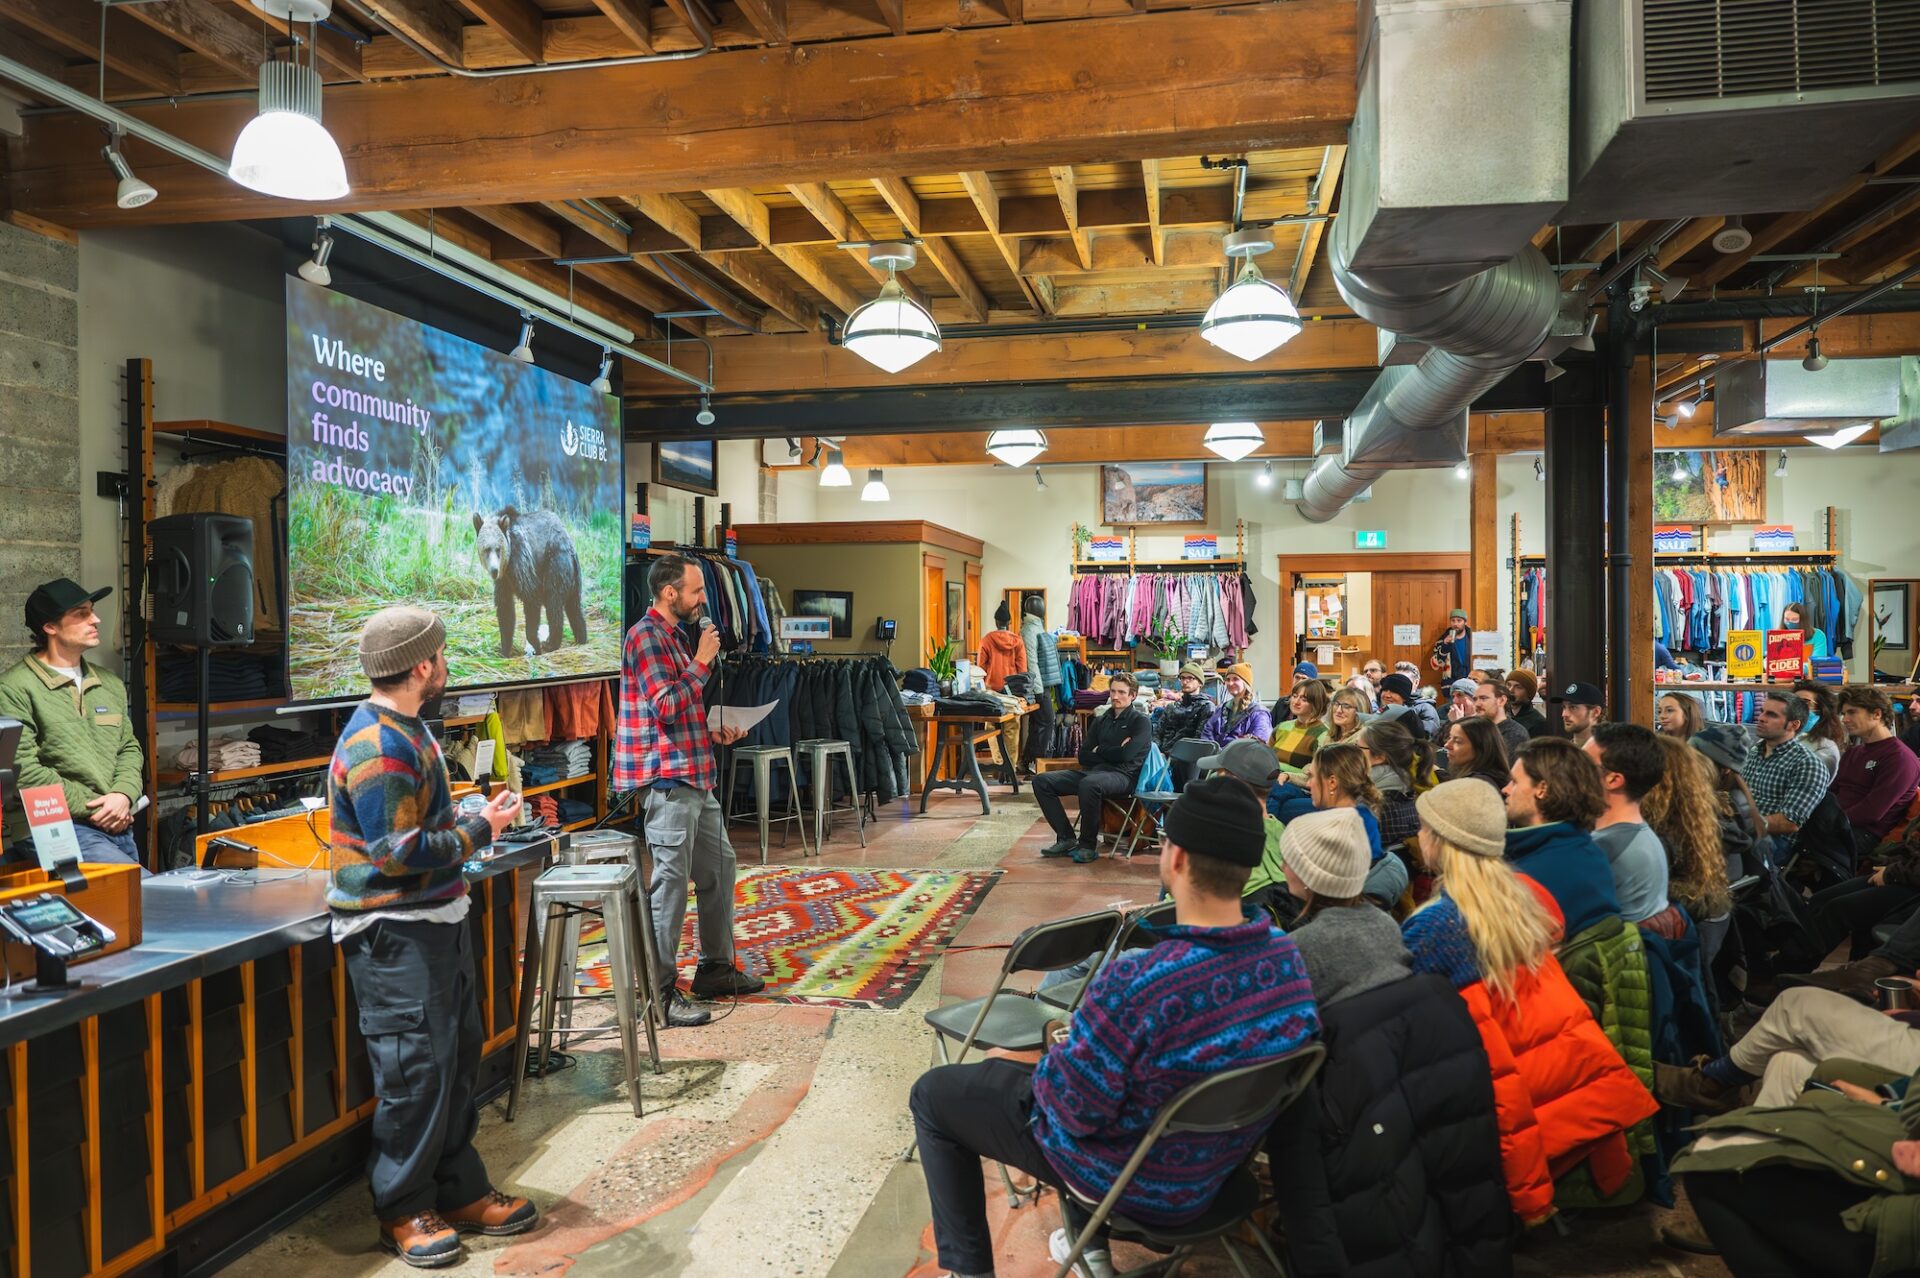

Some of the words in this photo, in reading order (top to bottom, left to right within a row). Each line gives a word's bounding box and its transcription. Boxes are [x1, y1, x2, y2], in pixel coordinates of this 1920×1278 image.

[312, 334, 385, 381] Where
[312, 381, 430, 436] community
[312, 412, 369, 452] finds
[580, 425, 605, 446] SIERRA
[580, 442, 597, 459] CLUB
[599, 447, 607, 462] BC
[312, 456, 414, 503] advocacy
[1188, 548, 1214, 558] SALE
[1660, 540, 1688, 550] SALE
[1769, 660, 1799, 670] CIDER
[33, 809, 46, 818] the
[46, 806, 64, 816] Loop
[34, 798, 51, 808] Stay
[51, 797, 58, 805] in
